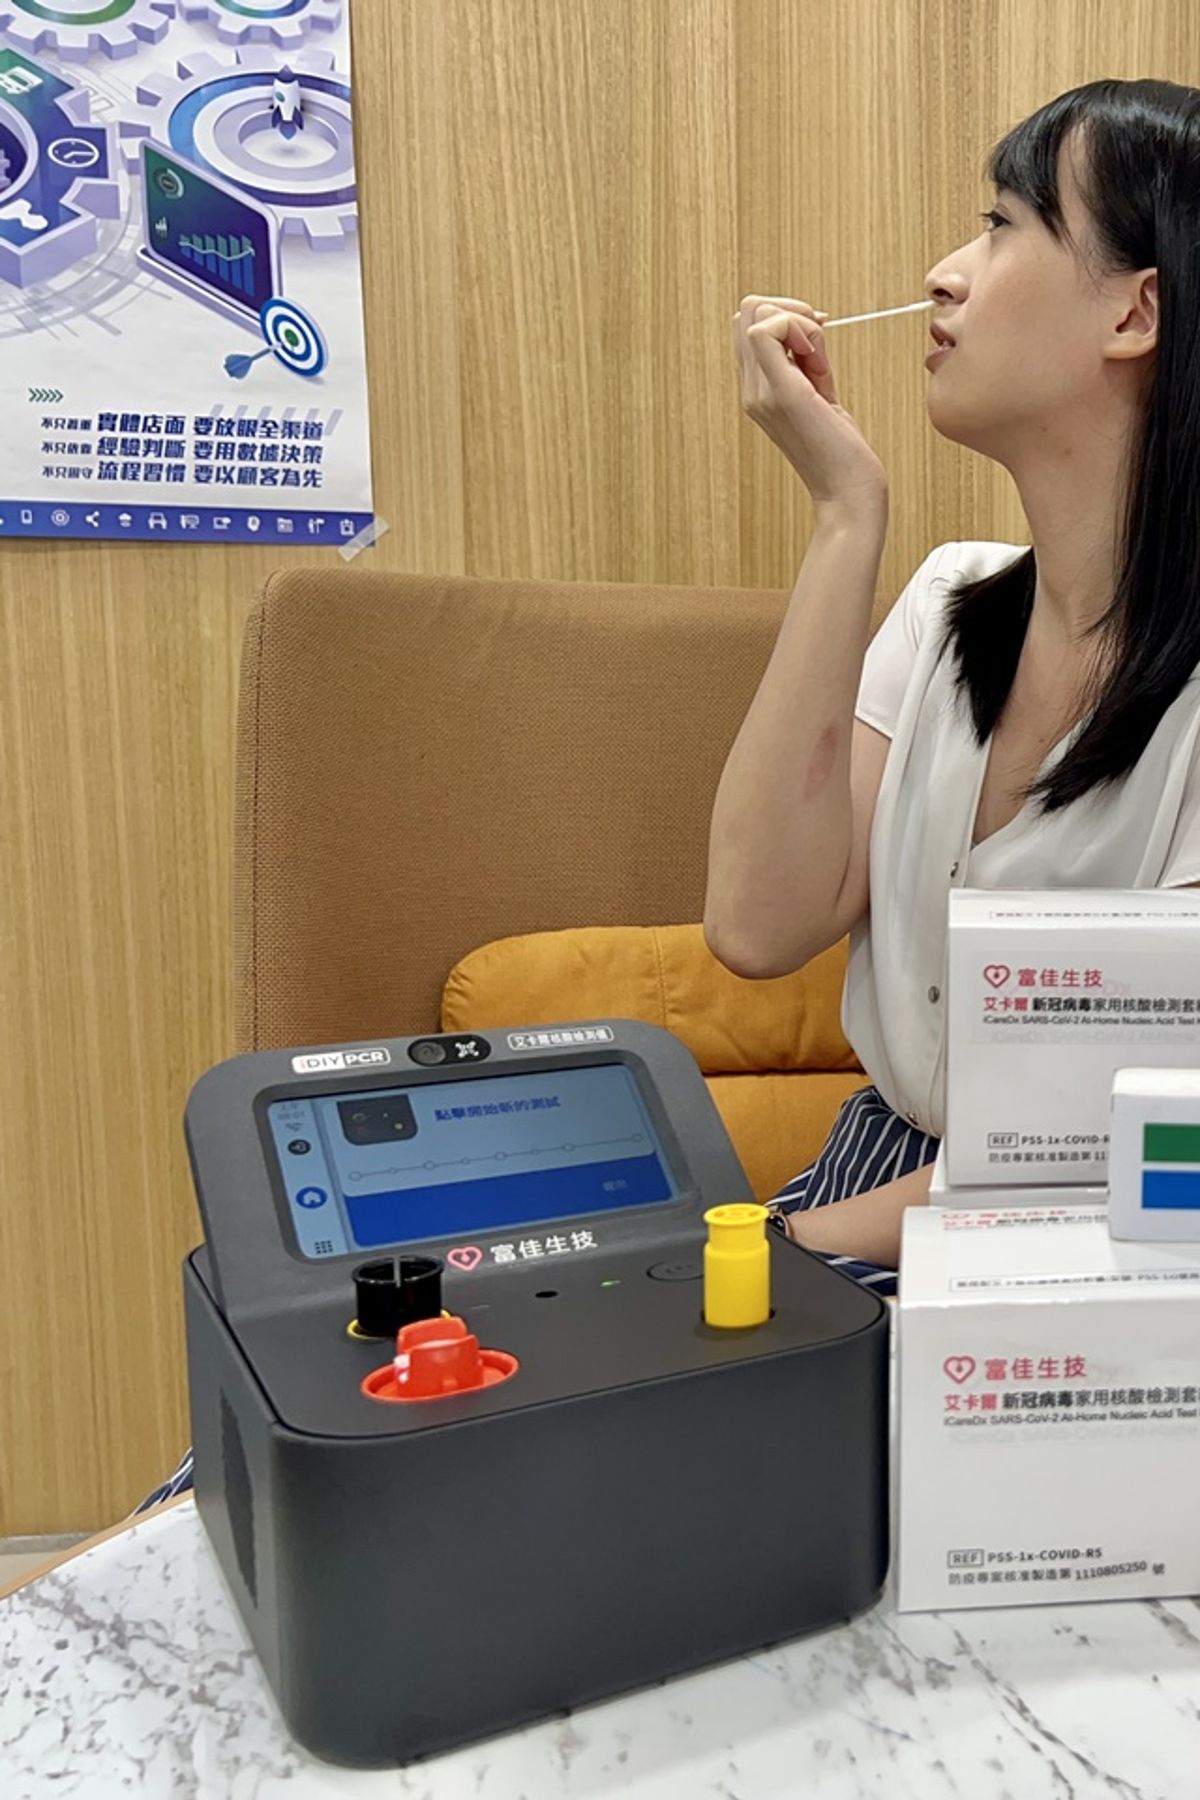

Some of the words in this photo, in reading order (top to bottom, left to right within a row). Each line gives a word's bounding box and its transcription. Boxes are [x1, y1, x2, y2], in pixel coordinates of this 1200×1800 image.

[97, 412, 186, 434] 實體店面
[193, 416, 323, 440] 要放眼全渠道
[97, 437, 186, 458] 經驗判斷
[193, 440, 323, 464] 要用數據決策
[97, 460, 186, 482] 流程習慣
[193, 464, 323, 488] 要以顧客為先
[1017, 968, 1103, 988] 富佳生技
[490, 1230, 598, 1263] 富佳生技
[985, 1356, 1087, 1381] 富佳生技
[1151, 1409, 1173, 1419] Acid
[1176, 1408, 1197, 1418] Test
[953, 1554, 978, 1564] REF
[1075, 1560, 1147, 1581] 1110805250
